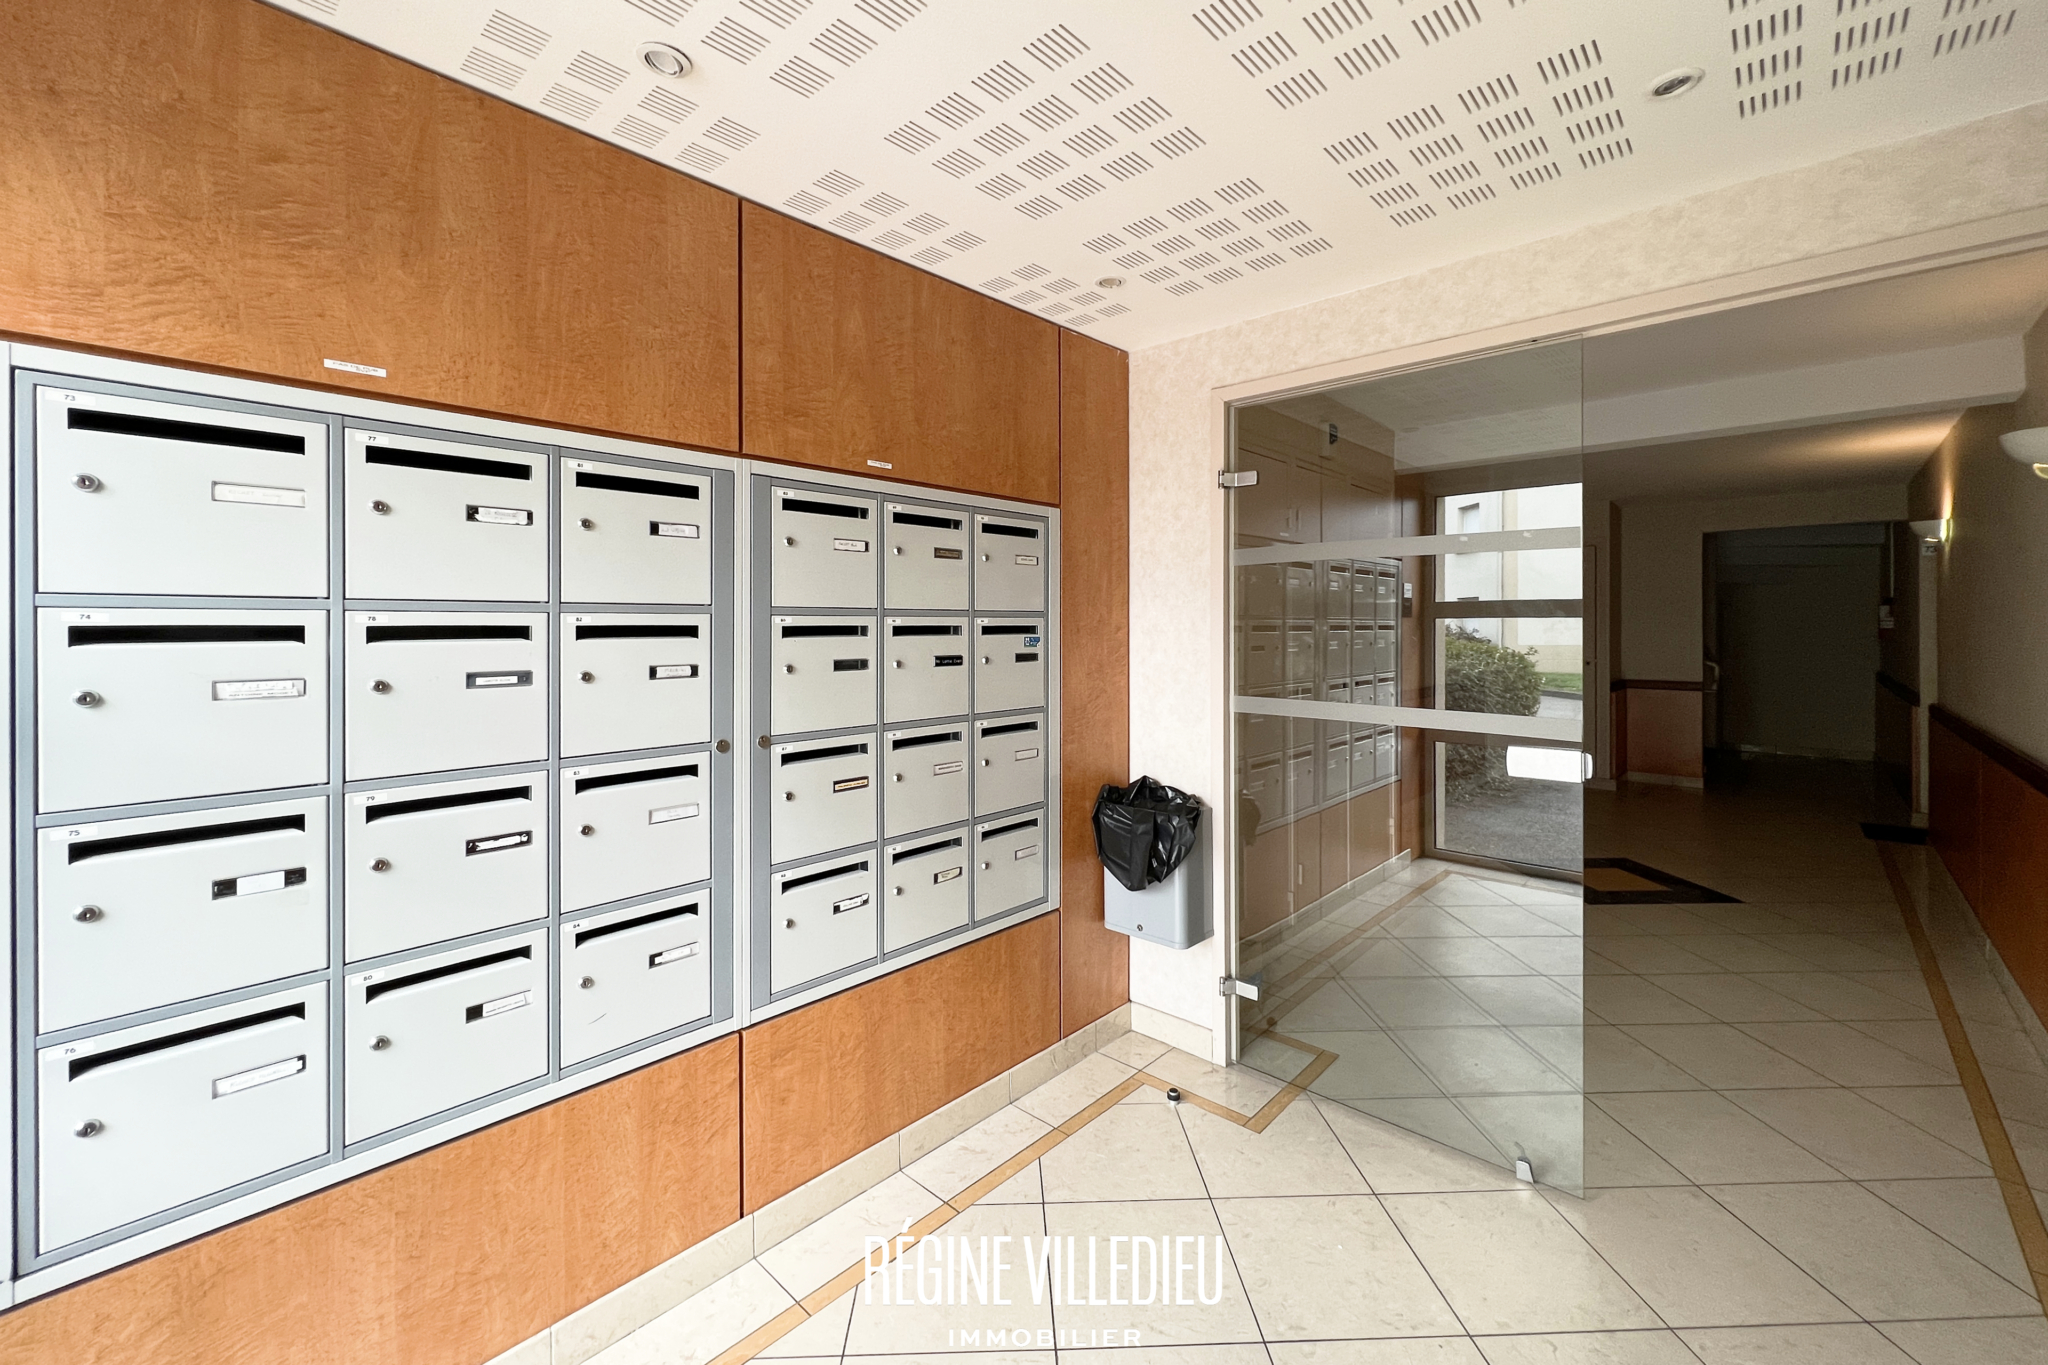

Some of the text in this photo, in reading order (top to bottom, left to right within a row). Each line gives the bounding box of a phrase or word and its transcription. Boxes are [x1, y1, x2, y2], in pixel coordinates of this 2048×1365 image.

[64, 393, 76, 402] 73
[68, 829, 81, 837] 75
[363, 974, 373, 982] 80
[64, 1047, 76, 1055] 76
